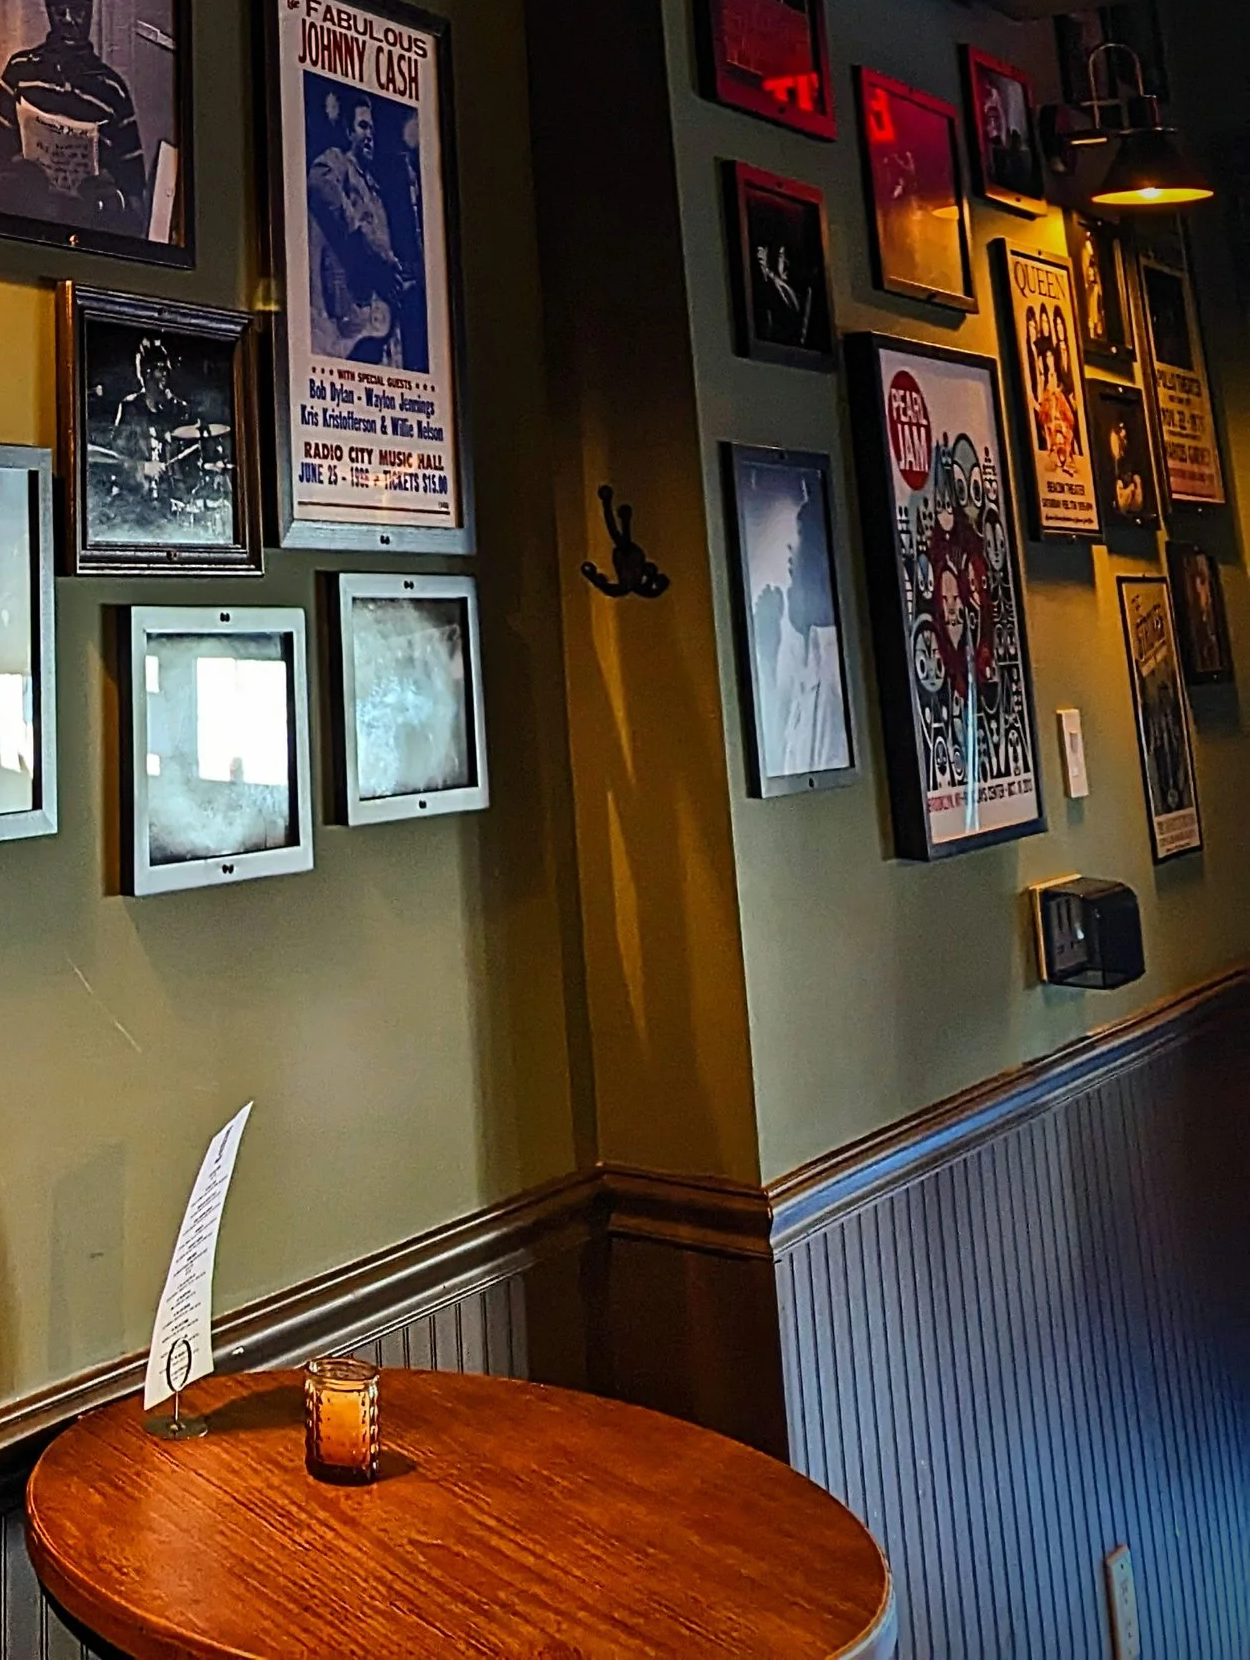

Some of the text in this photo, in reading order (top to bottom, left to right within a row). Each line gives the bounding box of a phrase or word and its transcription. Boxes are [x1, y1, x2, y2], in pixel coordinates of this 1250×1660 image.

[298, 18, 420, 102] JOHNNY CASH
[1014, 261, 1066, 301] QUEEN
[309, 378, 435, 419] Bob Dylan Waylon Jennings
[337, 368, 412, 391] WITH SPECIAL GUESTS
[300, 404, 444, 441] Kris Kristofferson & Willie Nelson
[890, 388, 928, 426] PEARL
[304, 441, 444, 471] RADIO CITY MUSIC HALL
[897, 423, 929, 472] JAM
[299, 461, 324, 484] JUNE
[327, 466, 338, 486] 25
[383, 470, 420, 493] TICKETS
